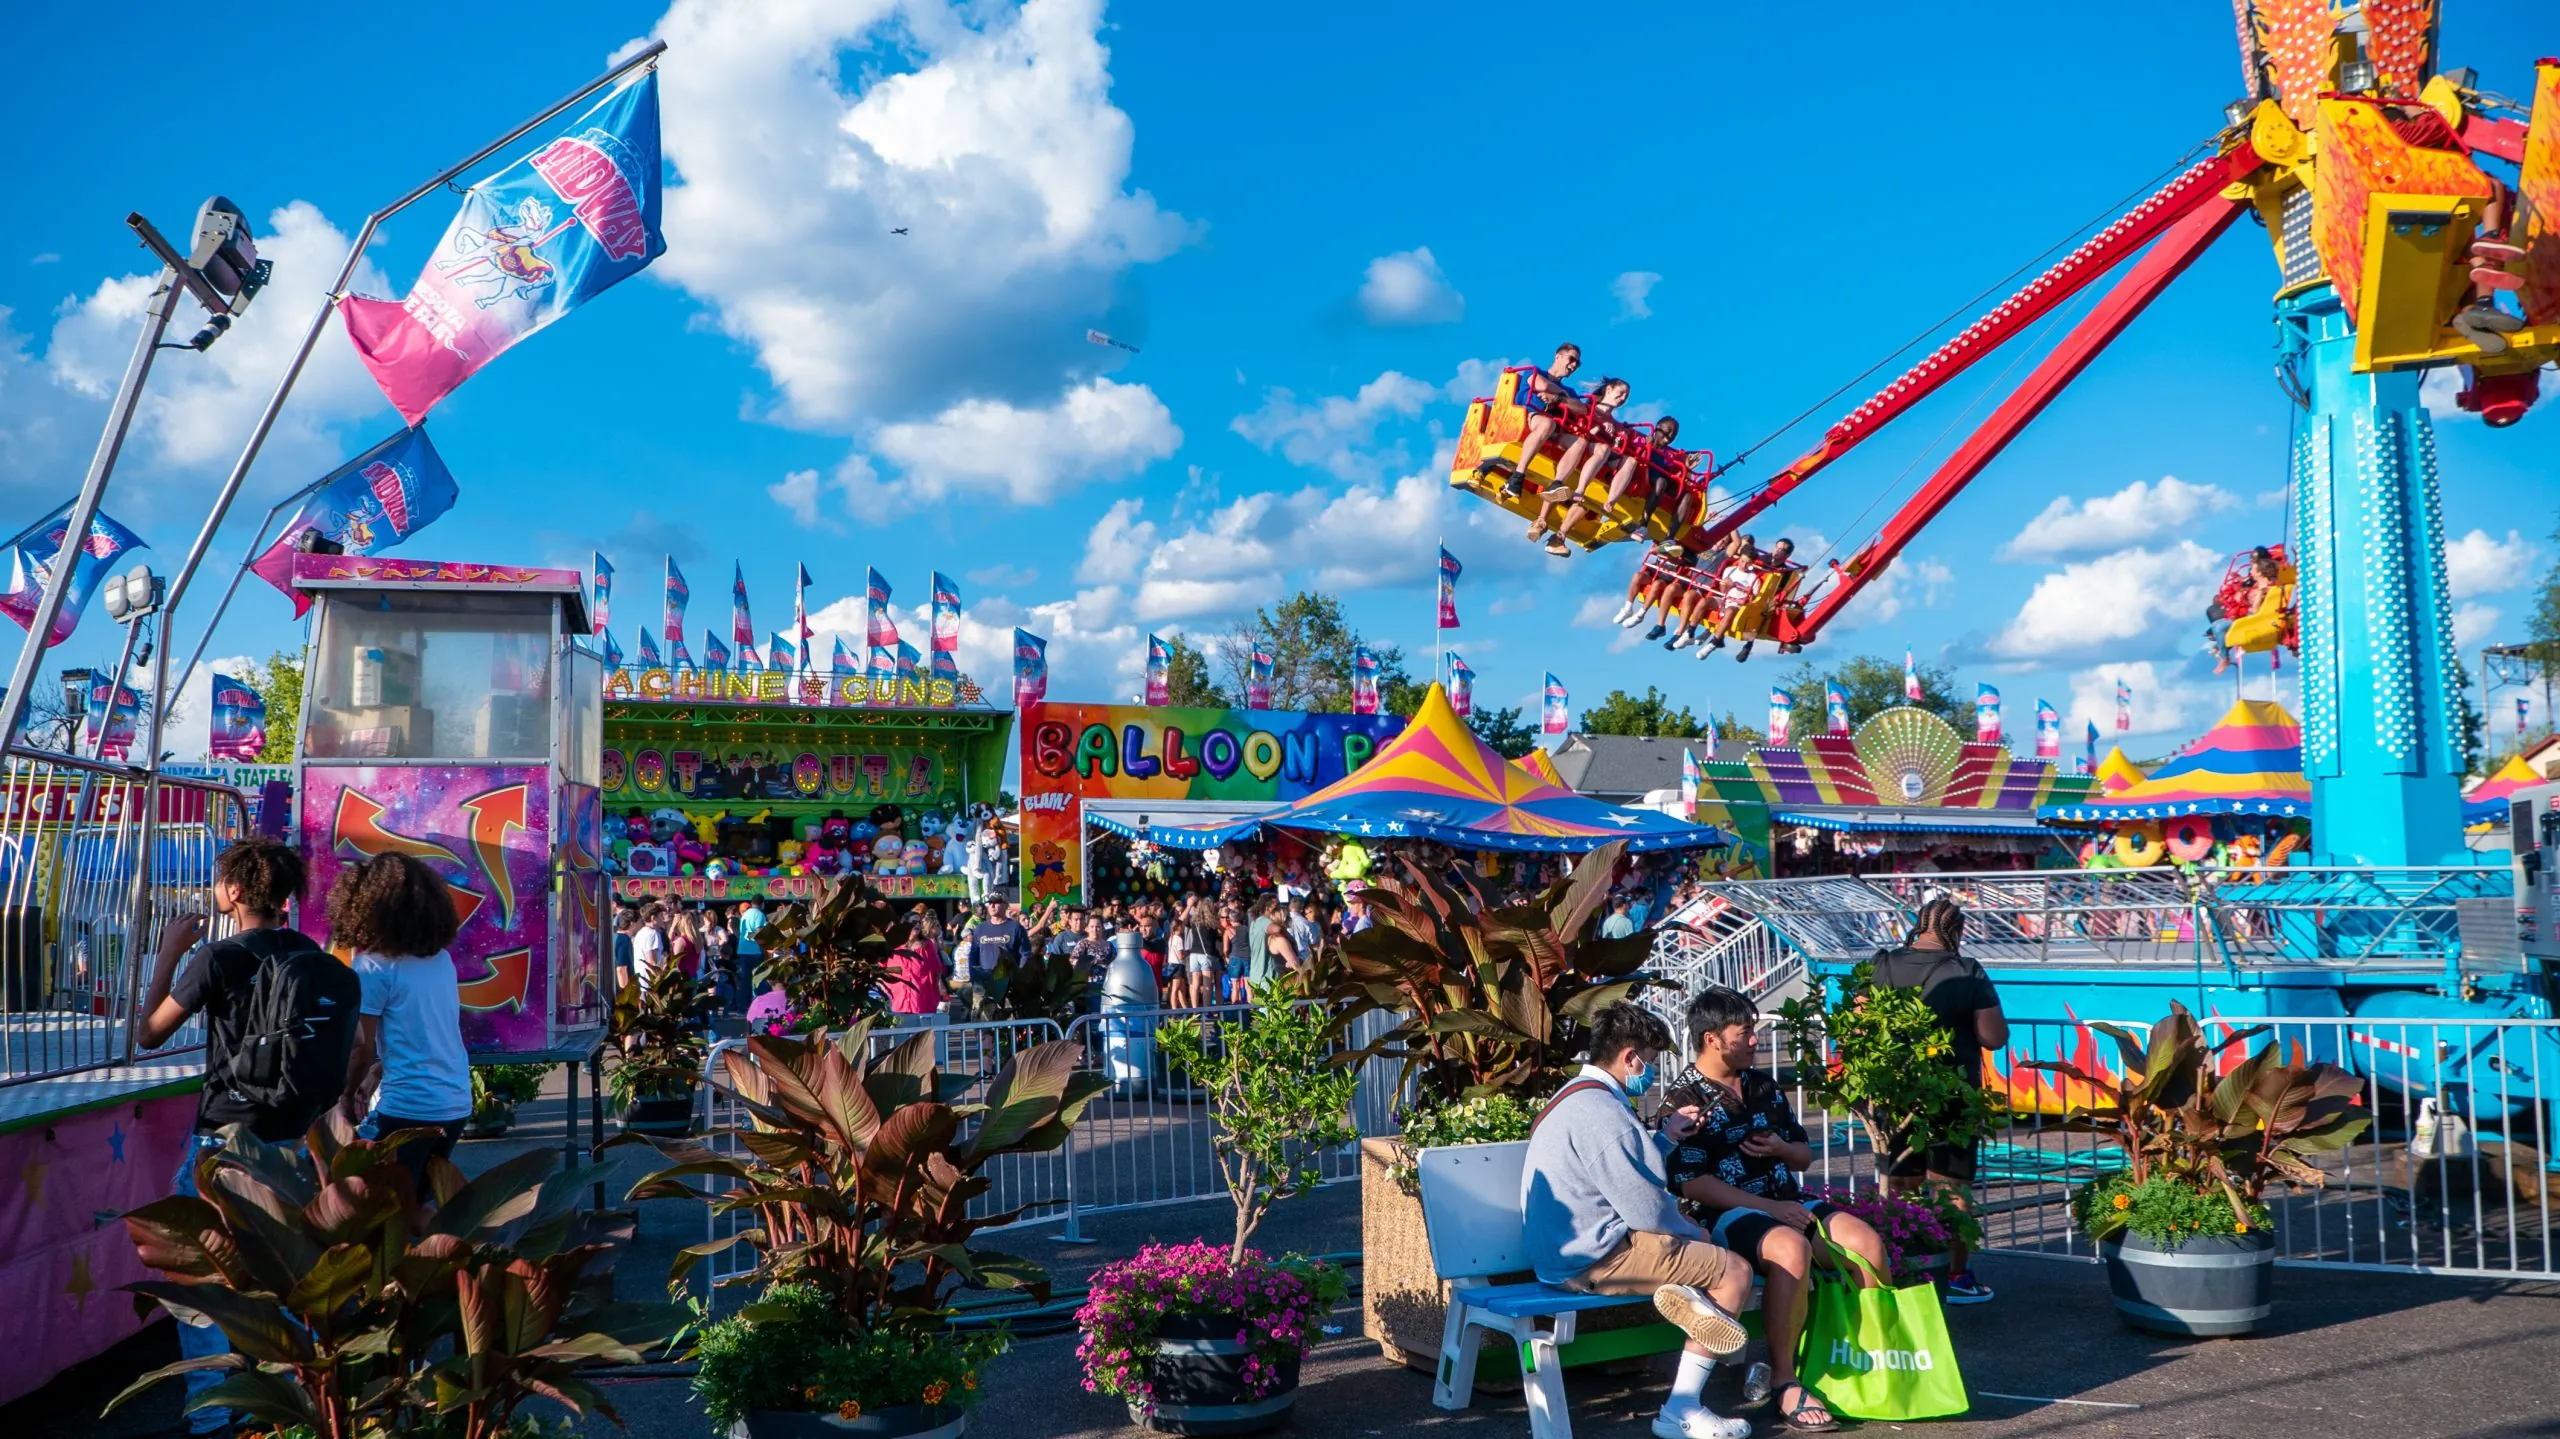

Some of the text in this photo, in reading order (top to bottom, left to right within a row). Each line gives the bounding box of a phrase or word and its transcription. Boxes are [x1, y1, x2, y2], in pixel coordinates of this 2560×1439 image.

[529, 137, 646, 262] MIDWAY
[412, 280, 467, 333] ESOTA
[360, 461, 410, 537] MIDWAY
[605, 668, 954, 706] ACHINE GUNS
[1033, 721, 1320, 786] BALLOON
[234, 768, 277, 787] STATE
[1024, 792, 1073, 812] BLAM!
[1831, 1338, 1933, 1371] Humana
